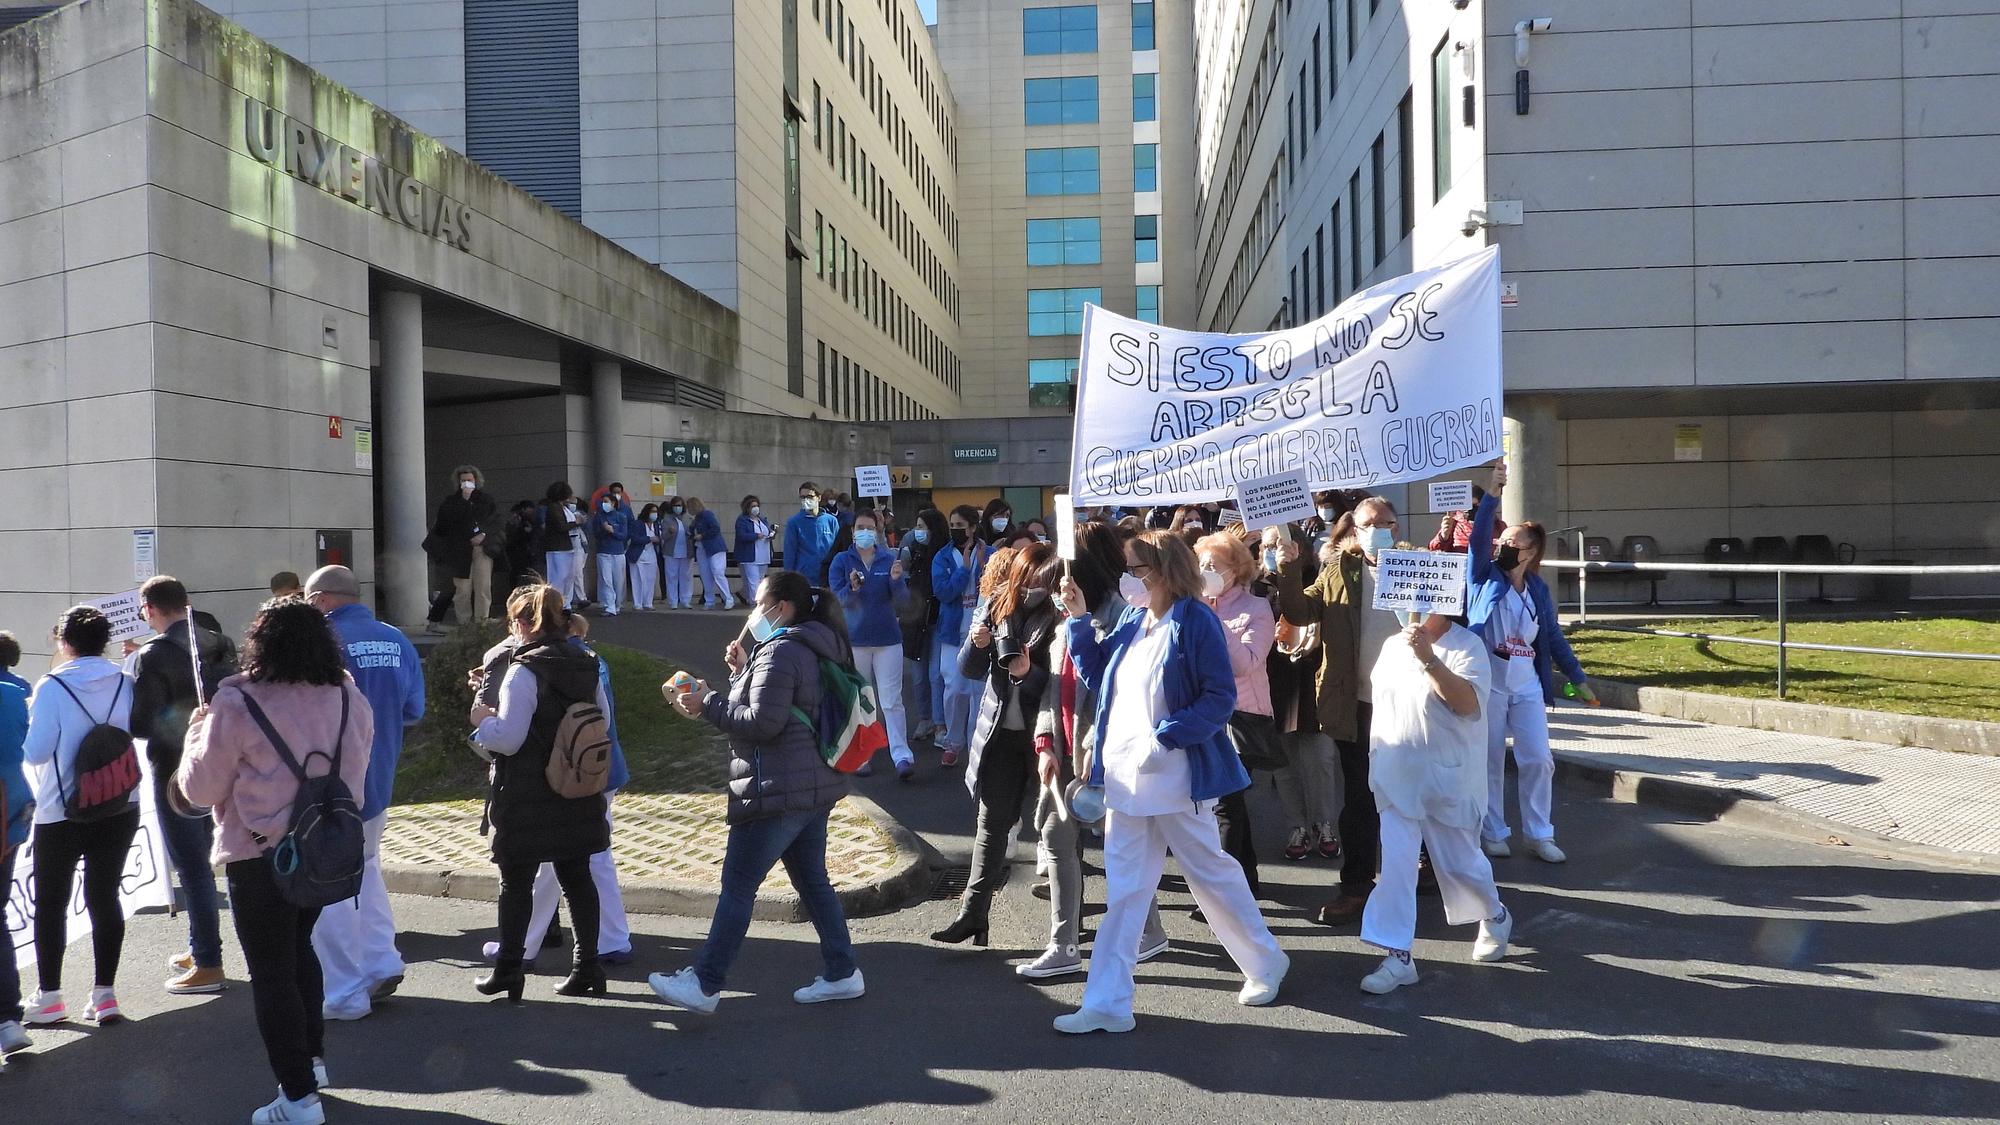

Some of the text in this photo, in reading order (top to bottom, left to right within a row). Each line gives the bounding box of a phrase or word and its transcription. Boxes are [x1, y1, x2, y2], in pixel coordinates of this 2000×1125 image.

[246, 97, 471, 253] URXENCIAS
[1173, 340, 1292, 392] ESTO
[1315, 313, 1373, 369] NO
[1382, 283, 1445, 350] SE
[1150, 360, 1398, 442] ARREGLA
[1381, 397, 1497, 473] GUERRA
[954, 449, 997, 458] URXENCIAS
[1245, 479, 1298, 496] LOS PACIENTES
[1266, 486, 1302, 499] URGENCIA
[1269, 494, 1305, 507] IMPORTAN
[1255, 511, 1272, 519] ESTA
[1273, 502, 1309, 515] GERENCIA
[1385, 558, 1458, 569] SEXTA OLA SIN
[1387, 569, 1439, 579] REFUERZO
[1393, 581, 1445, 591] PERSONAL
[1380, 592, 1457, 604] ACABA MUERTO
[105, 606, 135, 619] ERENTE
